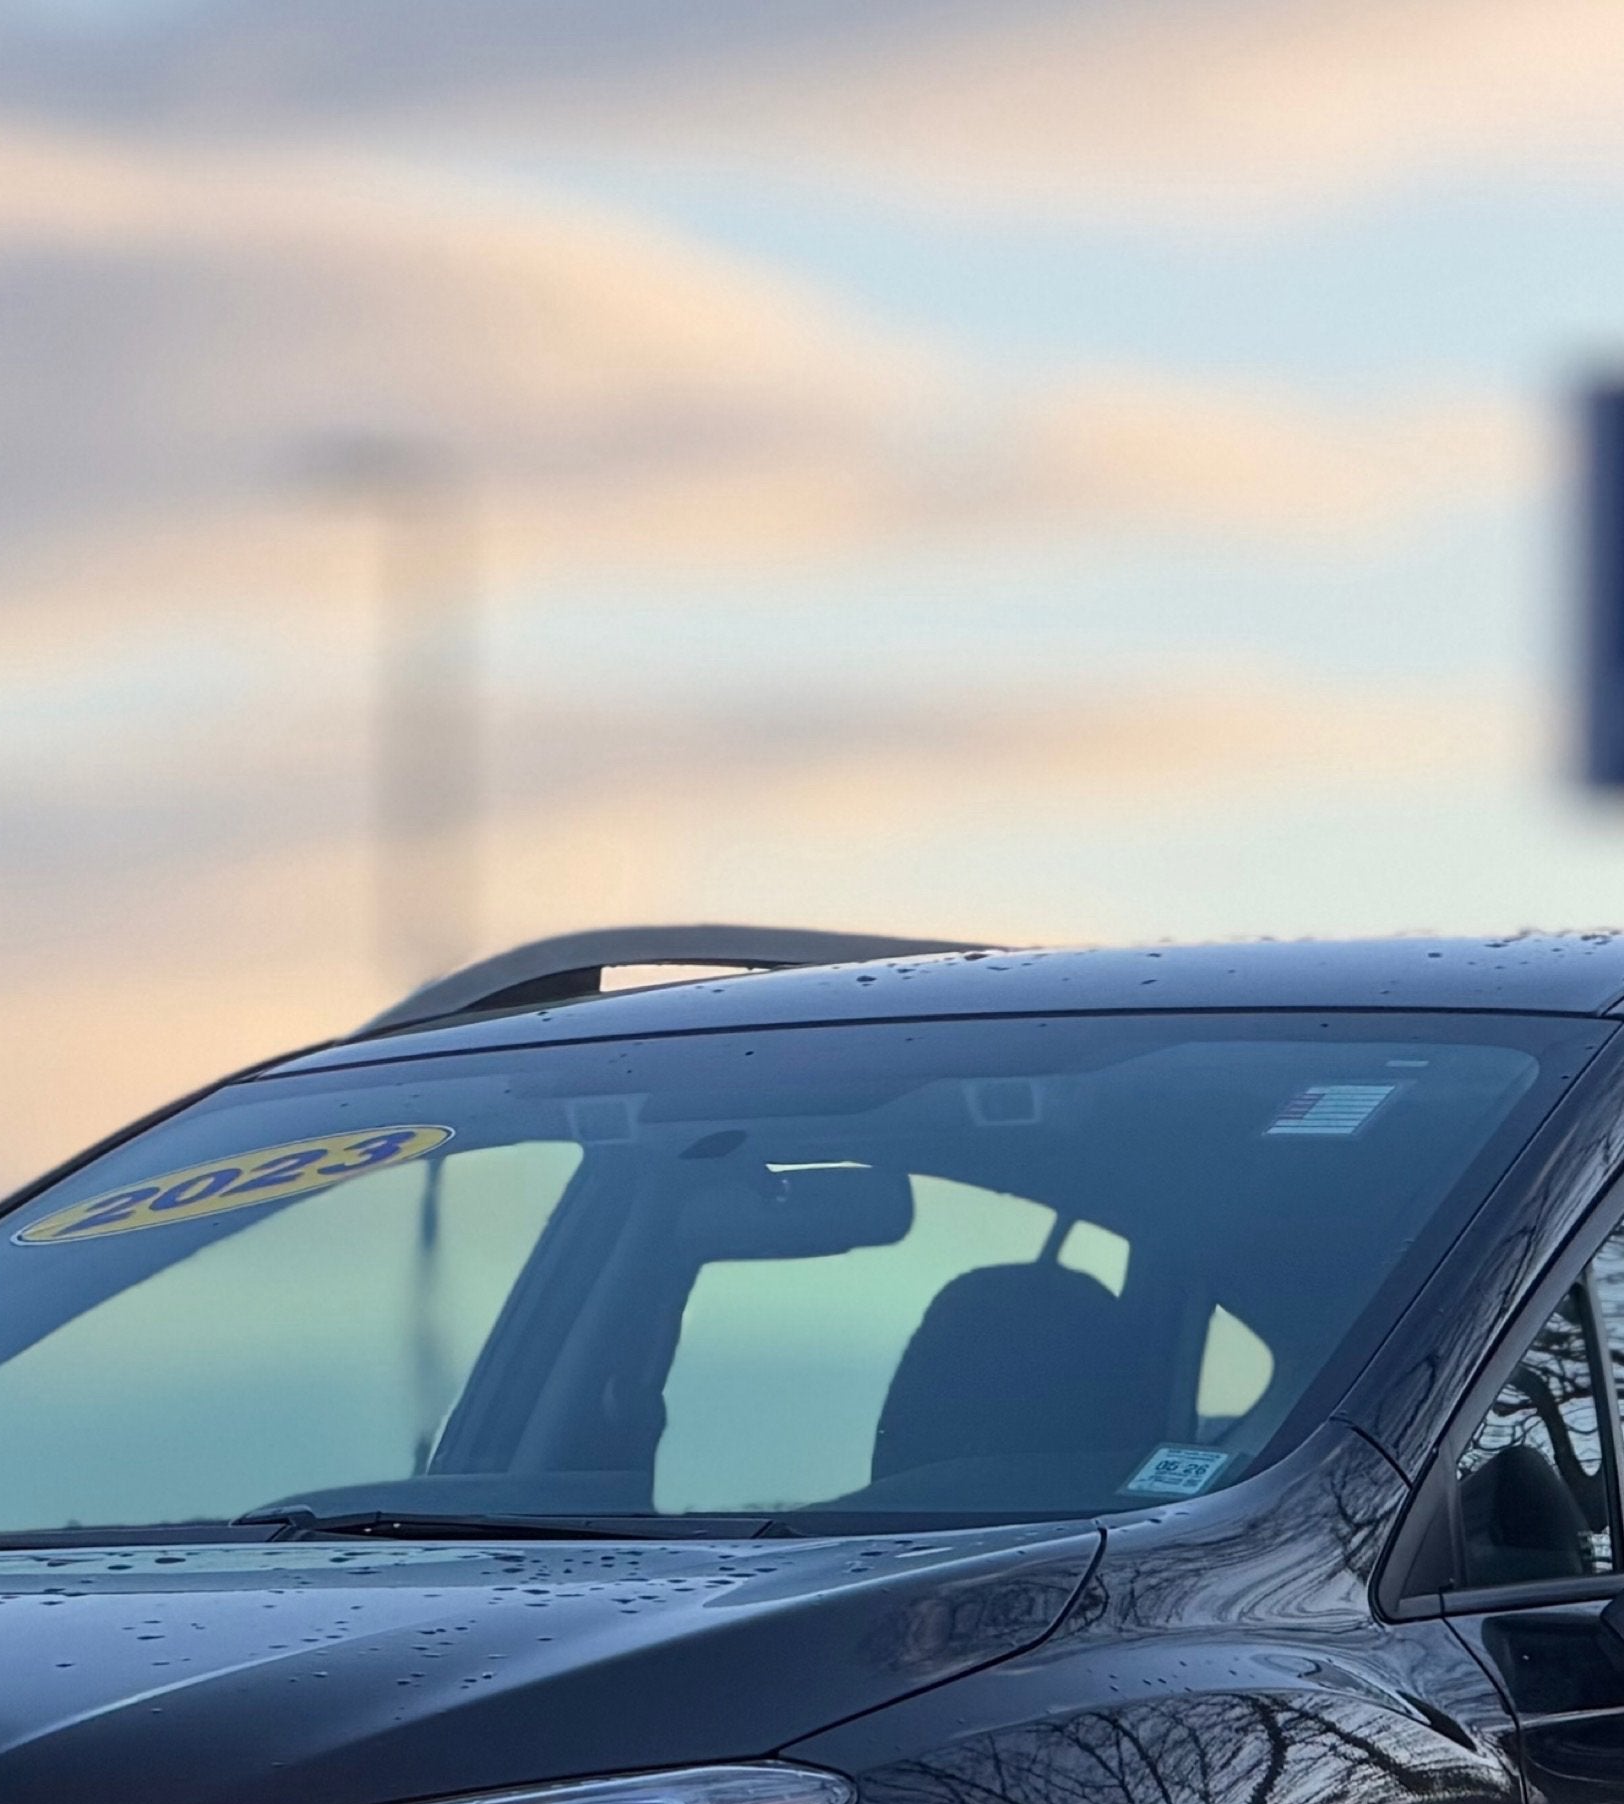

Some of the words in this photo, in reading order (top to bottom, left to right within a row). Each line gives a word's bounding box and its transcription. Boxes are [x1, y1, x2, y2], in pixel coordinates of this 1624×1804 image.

[52, 1131, 417, 1238] 2023
[1155, 1459, 1180, 1472] 05
[1183, 1463, 1210, 1476] 26
